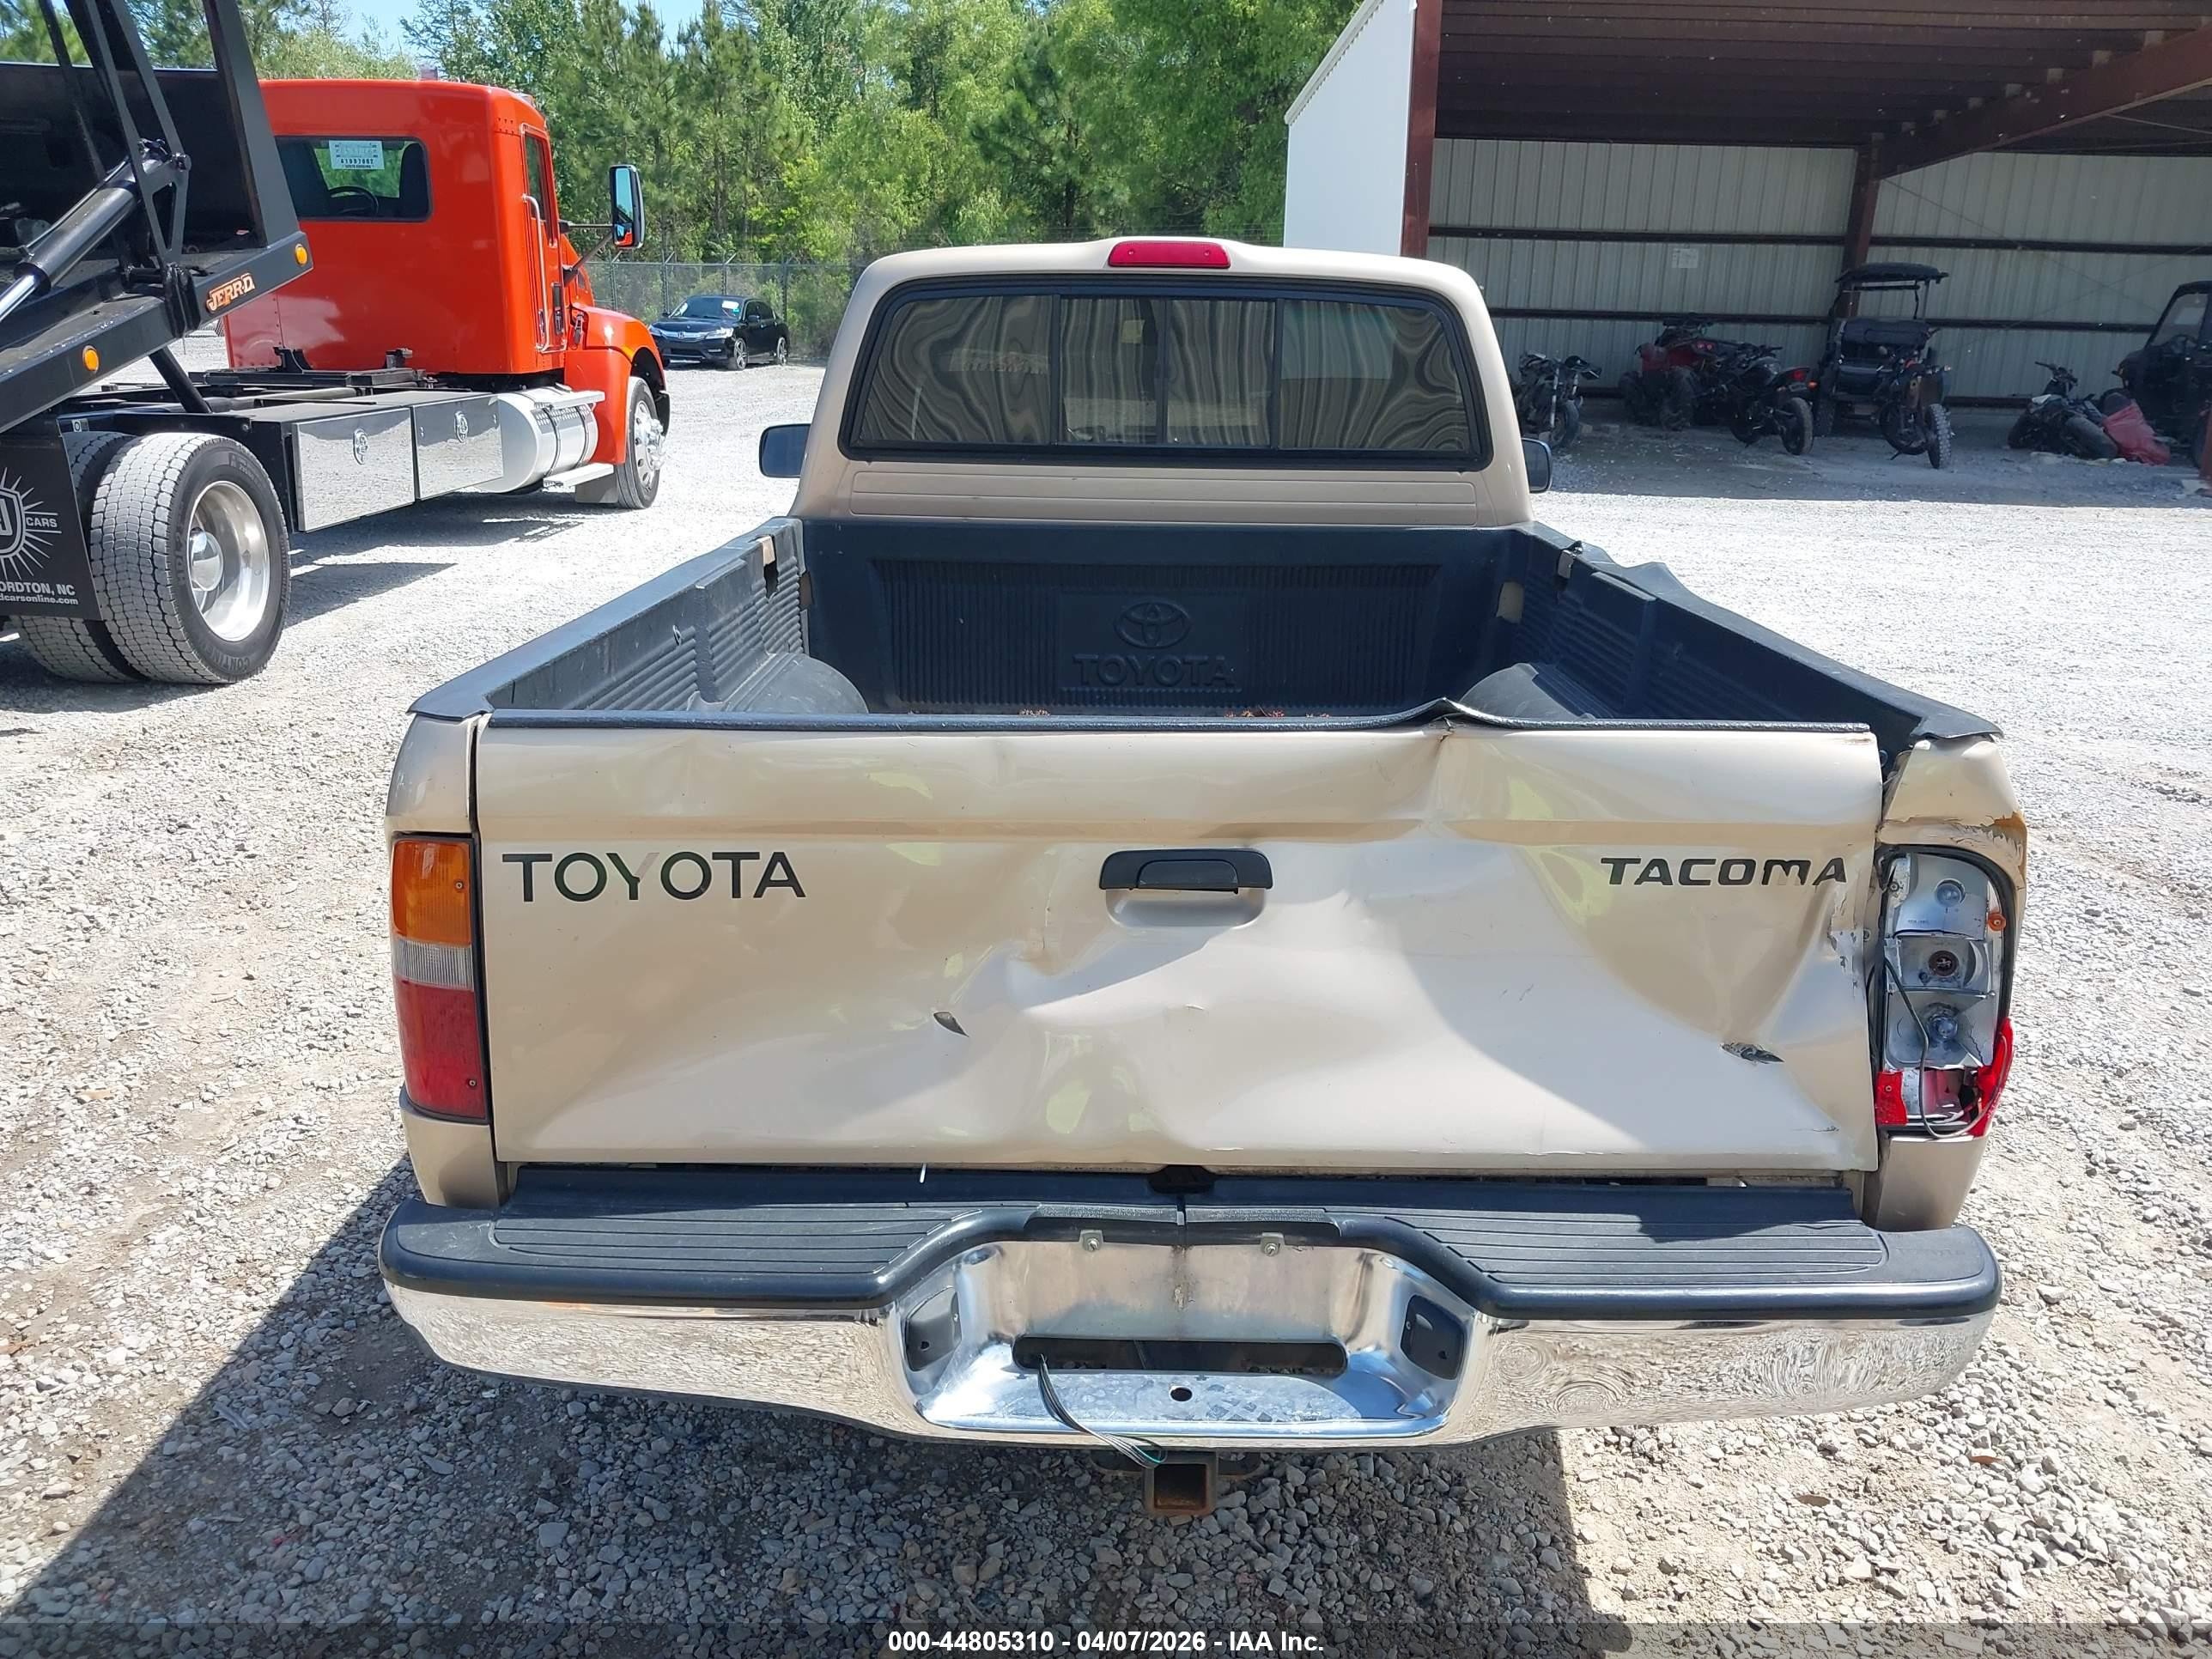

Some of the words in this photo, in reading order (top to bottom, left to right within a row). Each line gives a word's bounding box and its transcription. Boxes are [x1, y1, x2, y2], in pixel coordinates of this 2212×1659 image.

[26, 517, 58, 528] CARS
[57, 583, 76, 596] NC
[1073, 653, 1237, 688] TOYOTA
[501, 851, 807, 902] TOYOTA
[1600, 857, 1848, 886] TACOMA
